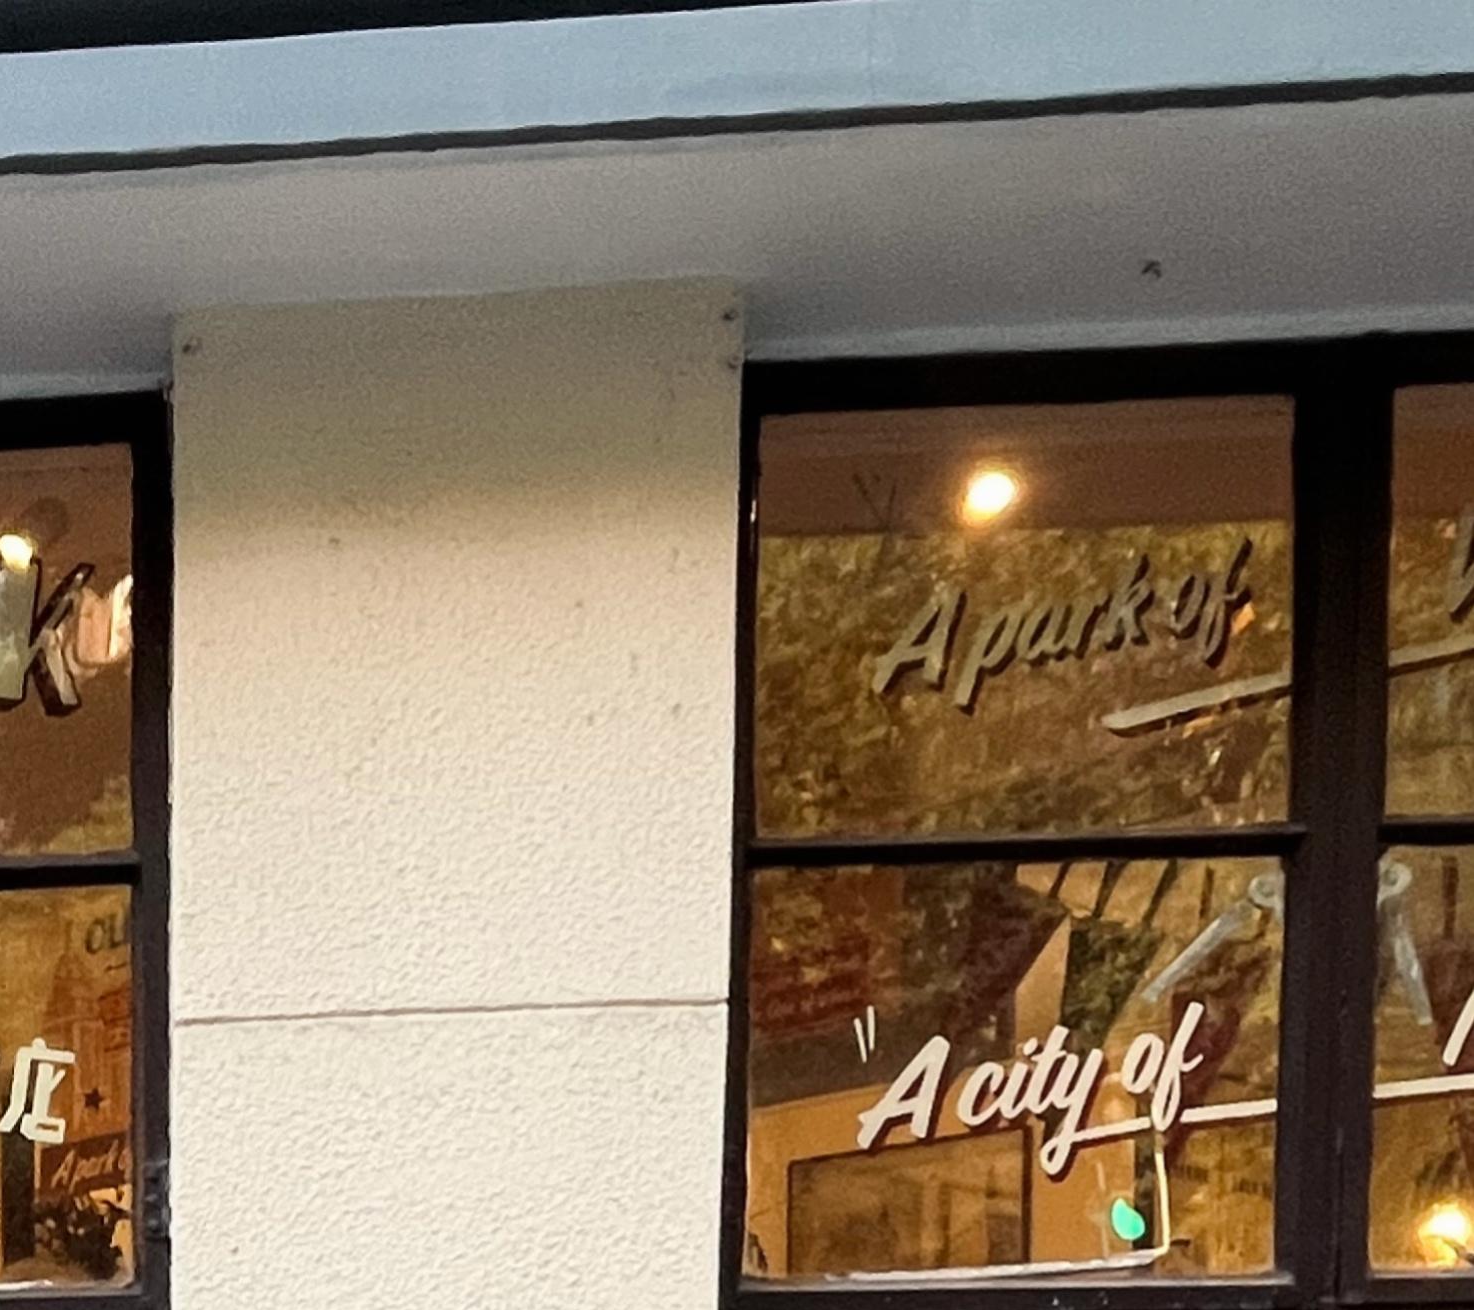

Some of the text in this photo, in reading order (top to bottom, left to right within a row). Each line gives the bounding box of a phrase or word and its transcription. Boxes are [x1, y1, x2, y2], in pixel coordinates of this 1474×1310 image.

[873, 538, 1254, 716] A park of
[957, 1024, 1104, 1186] city
[1121, 1001, 1205, 1133] of
